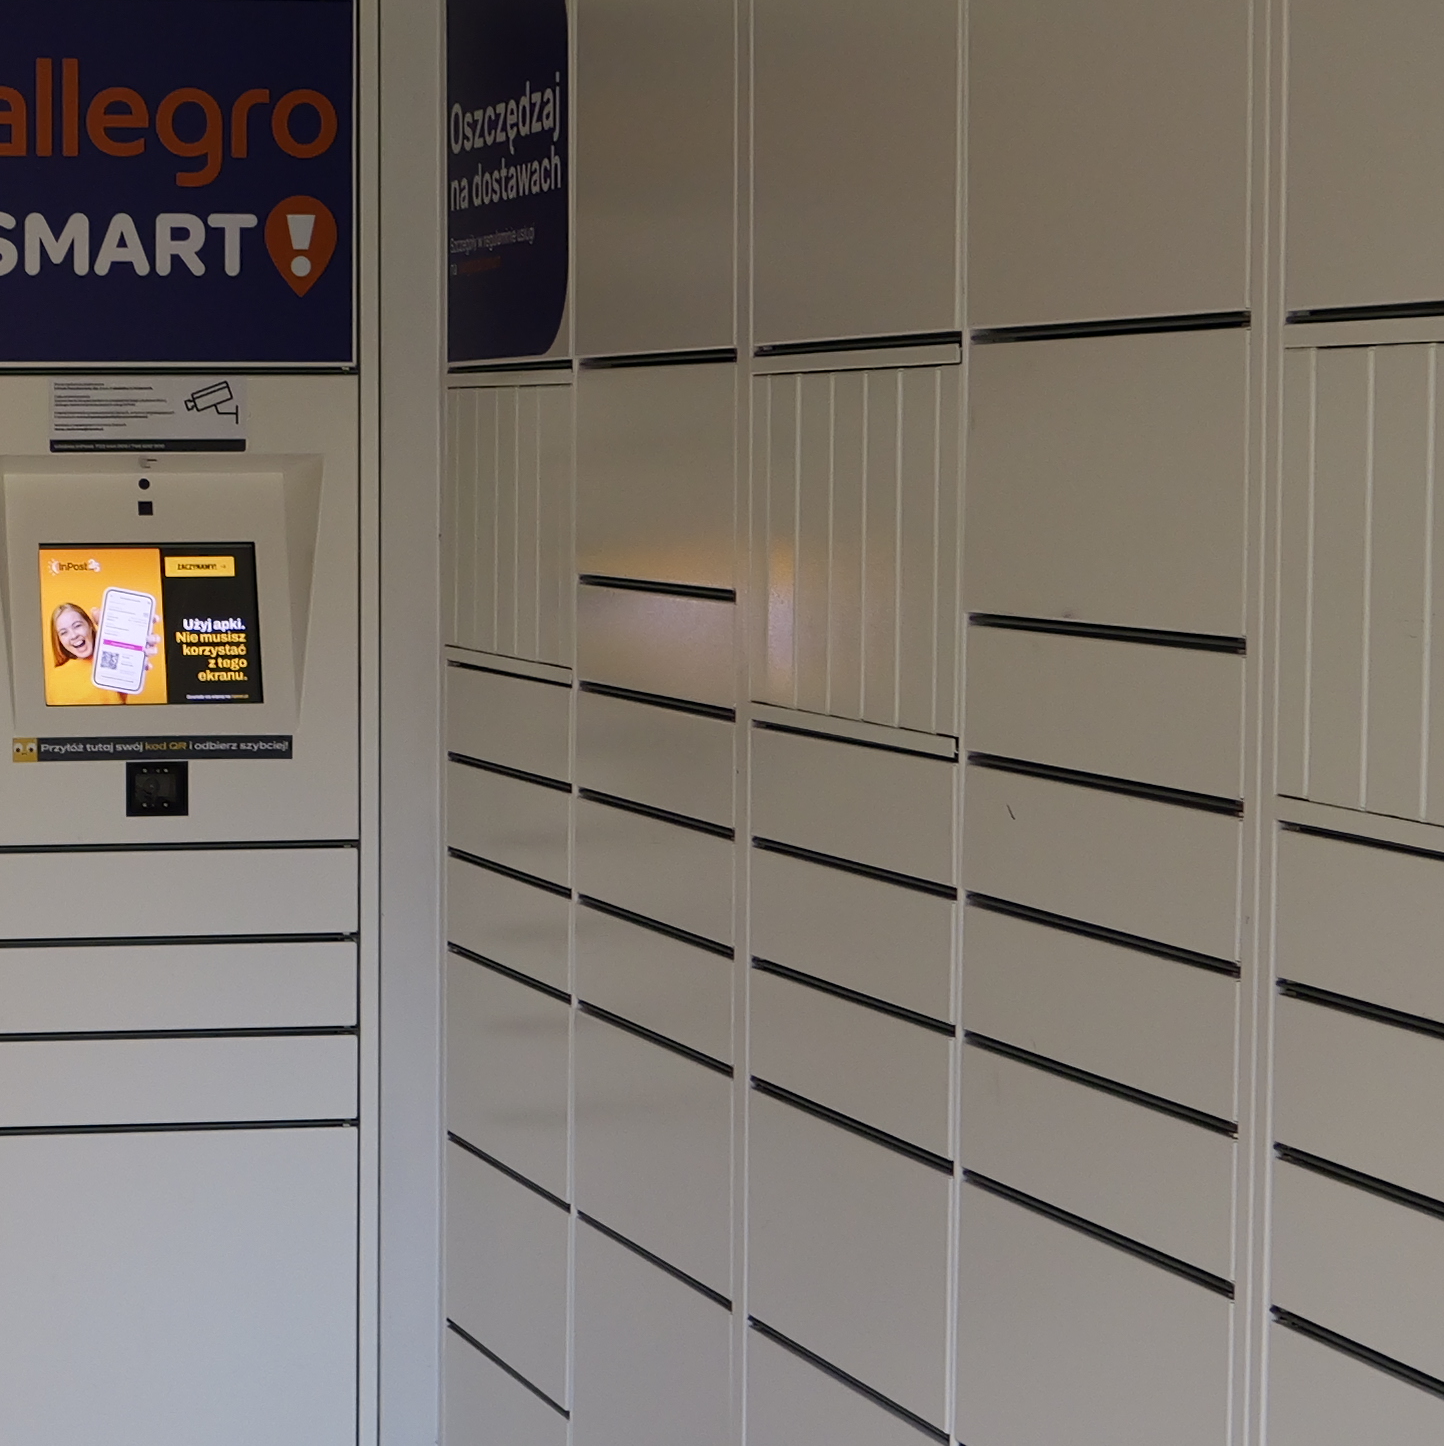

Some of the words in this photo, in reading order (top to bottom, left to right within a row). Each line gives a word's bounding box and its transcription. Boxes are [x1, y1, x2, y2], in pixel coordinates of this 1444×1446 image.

[449, 71, 561, 155] Oszczędzaj
[450, 177, 469, 212] na
[472, 144, 562, 207] dostawach
[58, 561, 88, 572] InPost
[182, 618, 212, 633] Użyj
[213, 618, 246, 632] apki.
[175, 632, 199, 643] Nie
[200, 631, 247, 643] musisz
[182, 644, 247, 657] korzystać
[207, 658, 217, 668] z
[217, 657, 248, 671] tego
[197, 669, 248, 681] ekranu.
[40, 742, 85, 753] Przyłóż
[86, 742, 114, 753] tutaj
[115, 741, 143, 753] swój
[144, 742, 167, 751] kod
[168, 742, 187, 751] QR
[194, 741, 238, 751] odbierz
[239, 740, 290, 753] szybciej!
